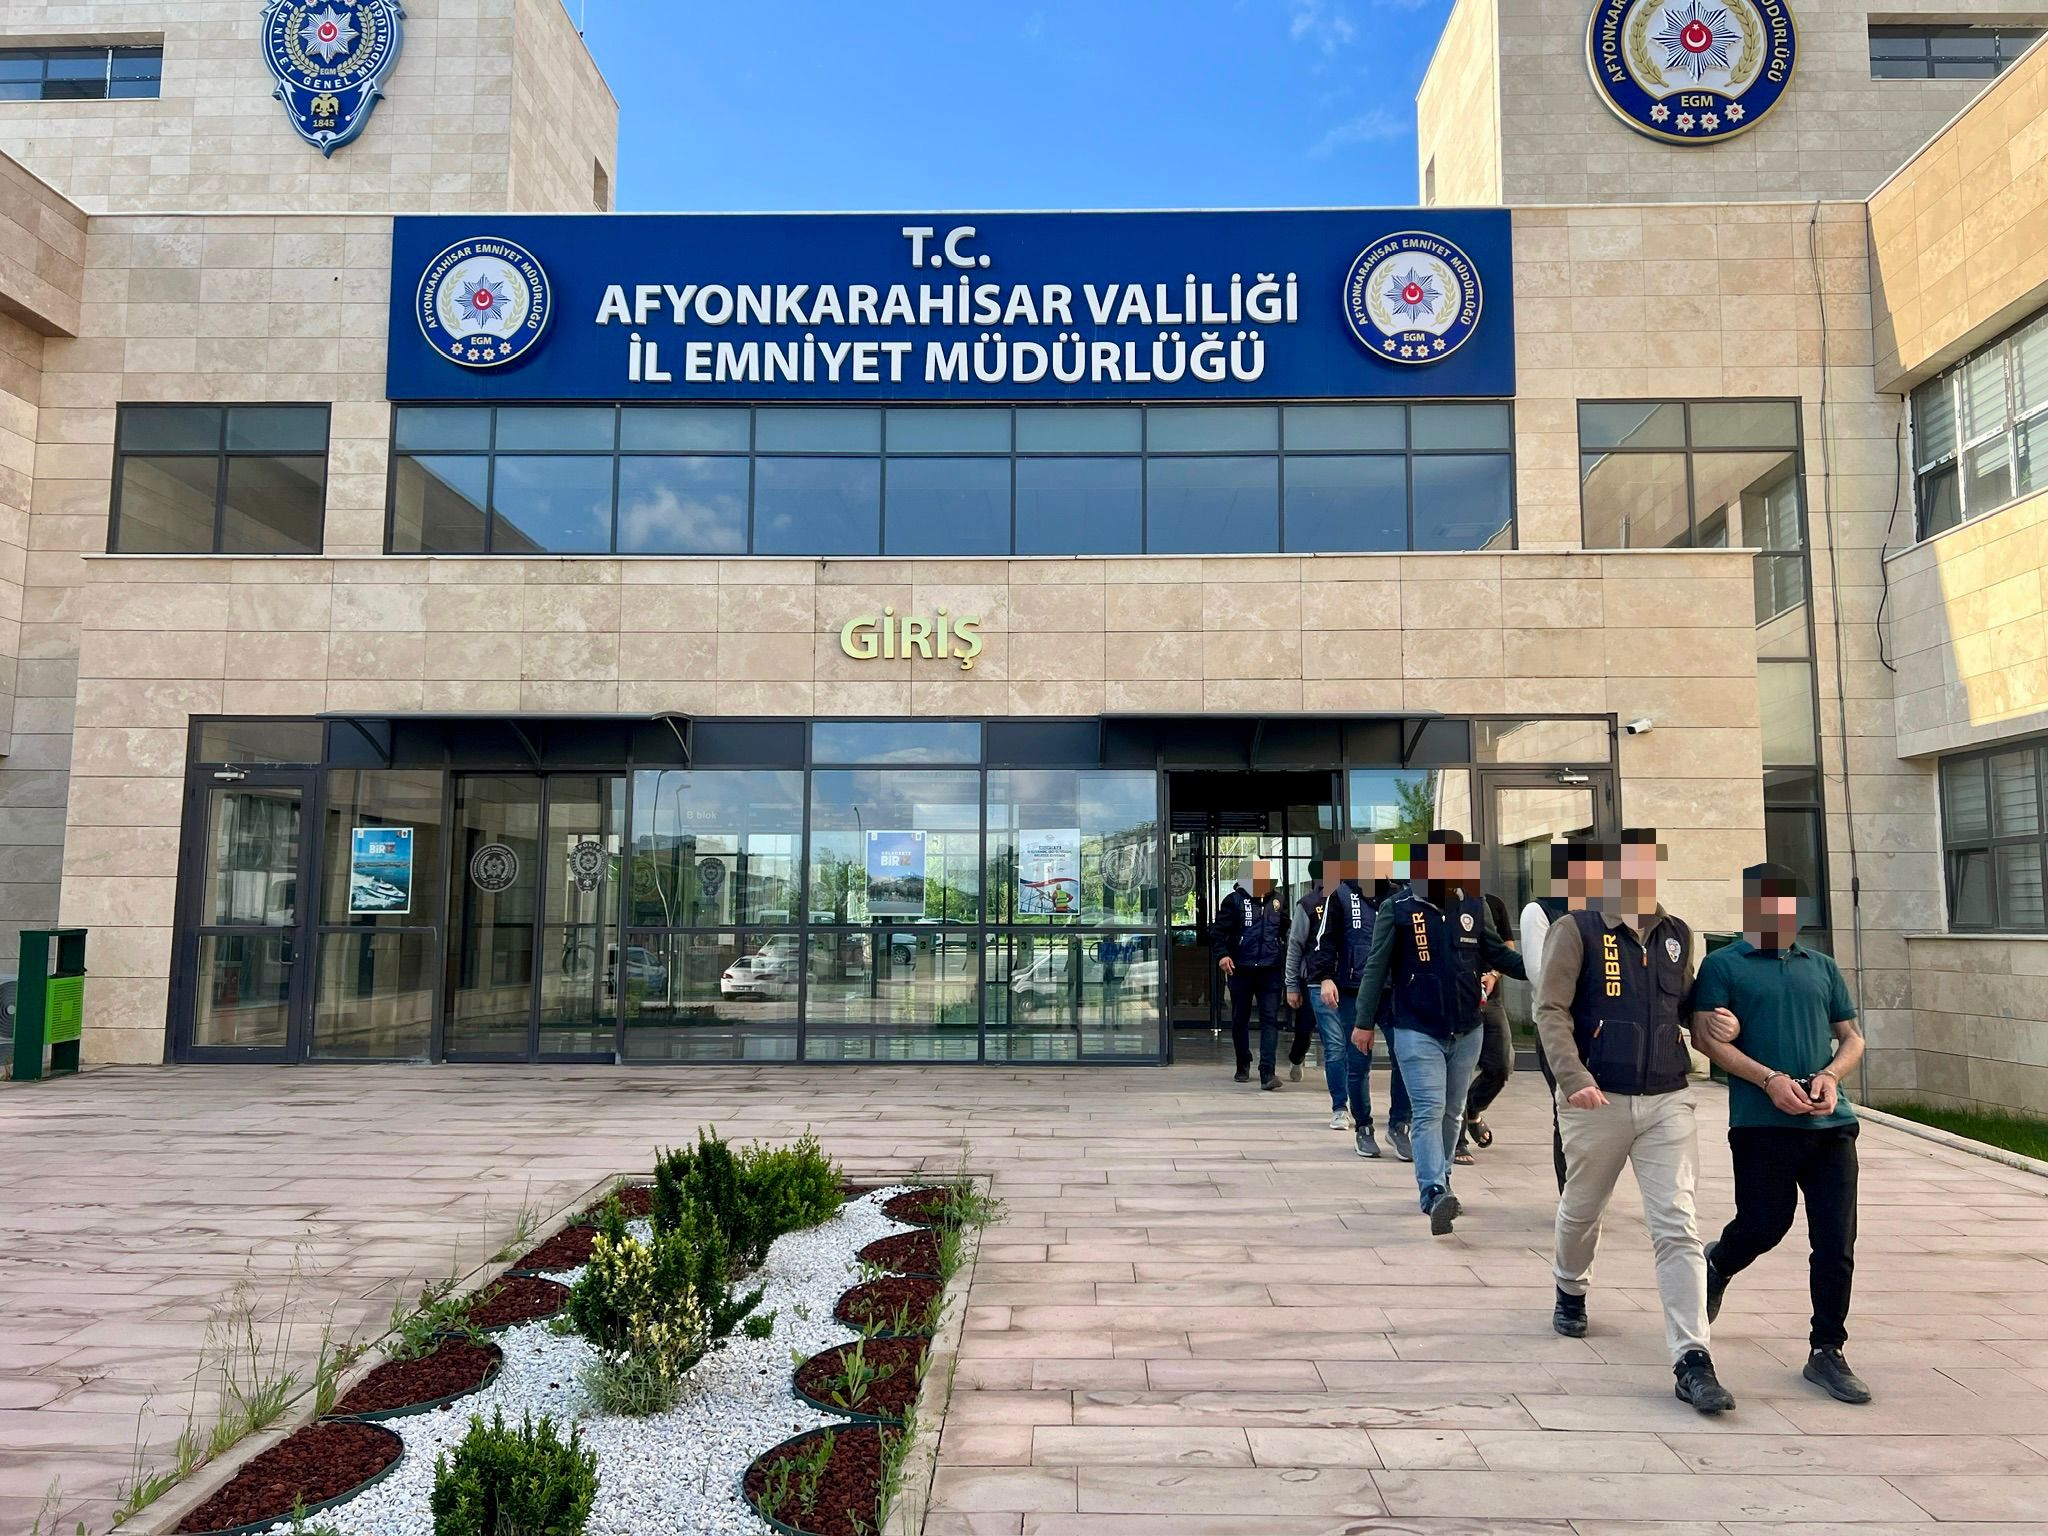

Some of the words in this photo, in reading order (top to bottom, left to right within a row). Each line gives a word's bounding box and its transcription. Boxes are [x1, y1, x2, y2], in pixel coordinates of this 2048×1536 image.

[1602, 0, 1628, 83] AFYONKAR
[303, 76, 352, 89] GENEL
[1680, 95, 1714, 107] EGM
[902, 226, 991, 268] T.C.
[423, 246, 472, 329] AFYONKARAHİSAR
[475, 243, 523, 262] EMNİYET
[521, 261, 544, 329] MÜDÜRLÜĞÜ
[595, 274, 1074, 327] AFYONKARAHİSAR
[1083, 271, 1299, 325] VALİLİĞİ
[1352, 241, 1399, 325] AFYONKARAHİSAR
[1402, 238, 1451, 257] EMNİYET
[1450, 256, 1477, 325] MÜDÜRLÜĞÜ
[470, 336, 492, 345] EGM
[627, 331, 673, 384] İL
[684, 332, 912, 384] EMNİYET
[924, 330, 1267, 384] MÜDÜRLÜĞÜ
[1403, 333, 1426, 342] EGM
[840, 605, 983, 670] GİRİŞ
